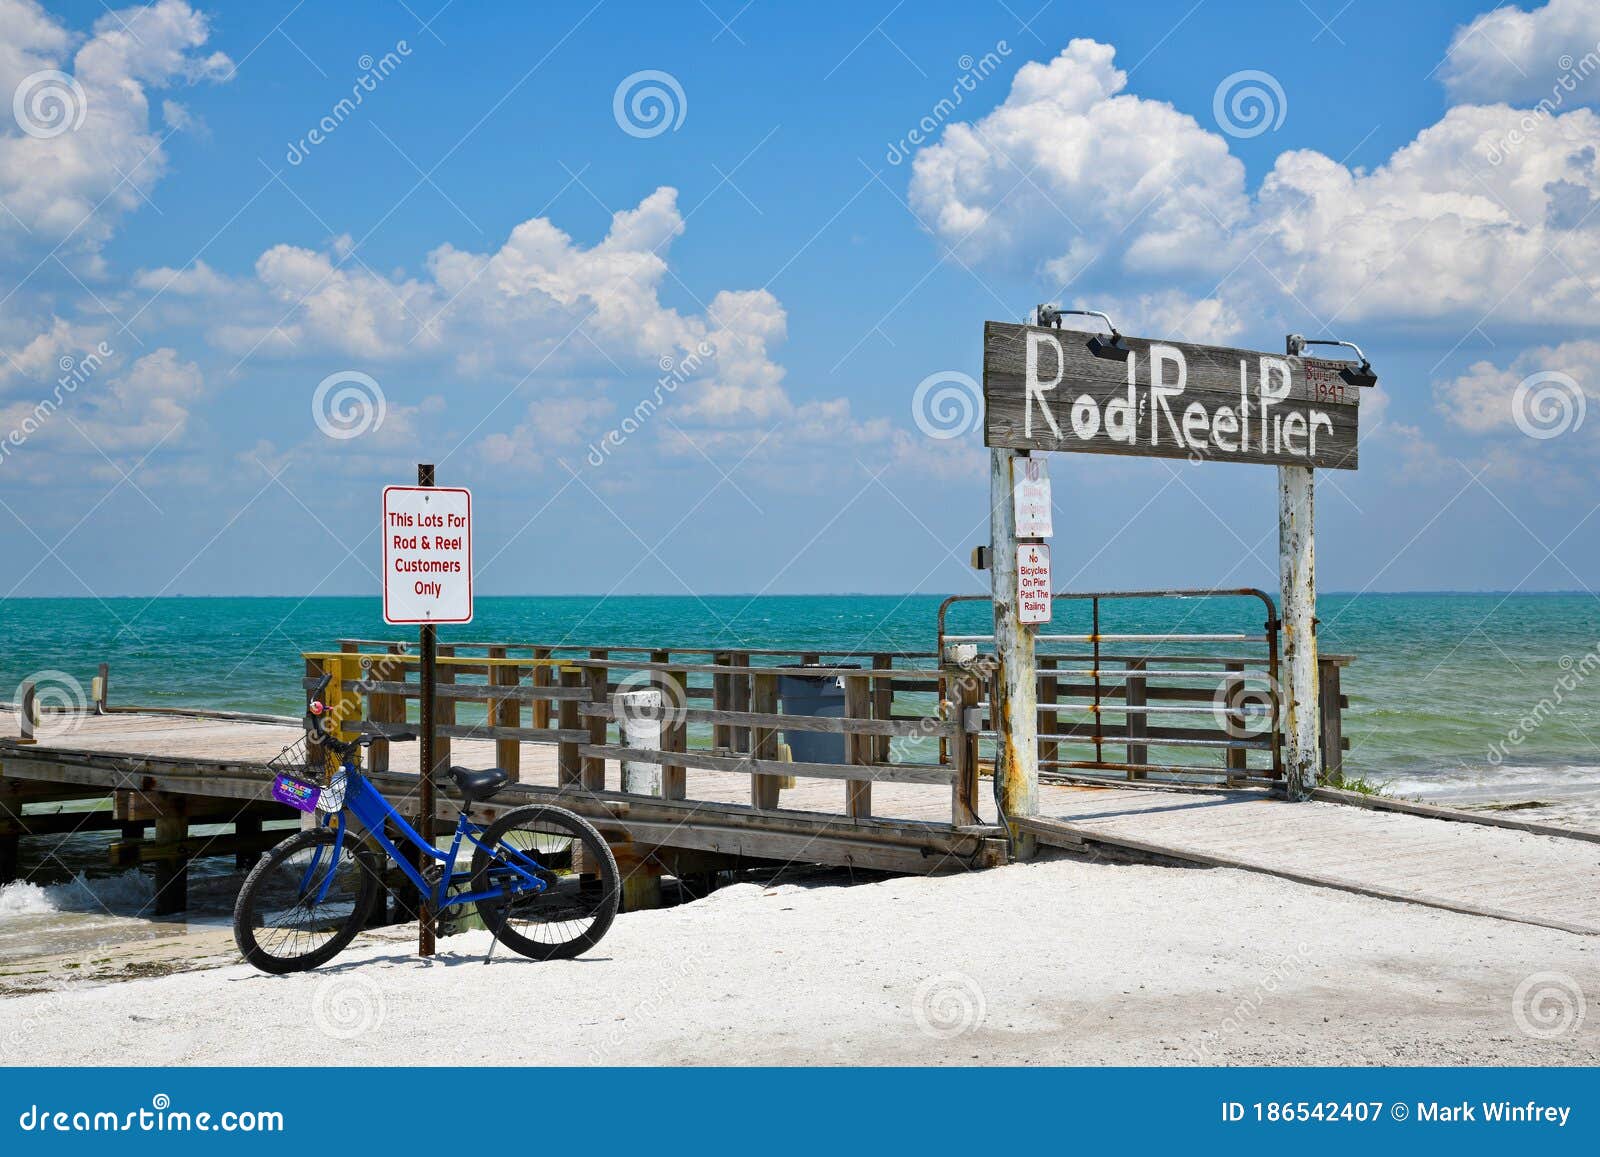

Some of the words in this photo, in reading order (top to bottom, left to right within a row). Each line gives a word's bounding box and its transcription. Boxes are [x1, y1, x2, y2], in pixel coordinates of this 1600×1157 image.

[1025, 331, 1136, 445] Rod
[1150, 344, 1248, 452] Reel
[1260, 356, 1334, 456] Pier
[1315, 384, 1345, 402] 1947
[388, 512, 413, 527] This
[417, 512, 443, 528] Lots
[448, 513, 466, 528] For
[393, 535, 417, 550] Rod
[421, 535, 431, 550] &
[435, 536, 462, 550] Reel
[395, 558, 461, 573] Customers
[1029, 554, 1038, 563] No
[1020, 566, 1048, 576] Bicycles
[414, 581, 442, 599] Only
[1022, 578, 1032, 587] On
[1033, 578, 1046, 587] Pier
[1020, 590, 1035, 599] Past
[1036, 589, 1049, 599] The
[1024, 602, 1046, 613] Railing
